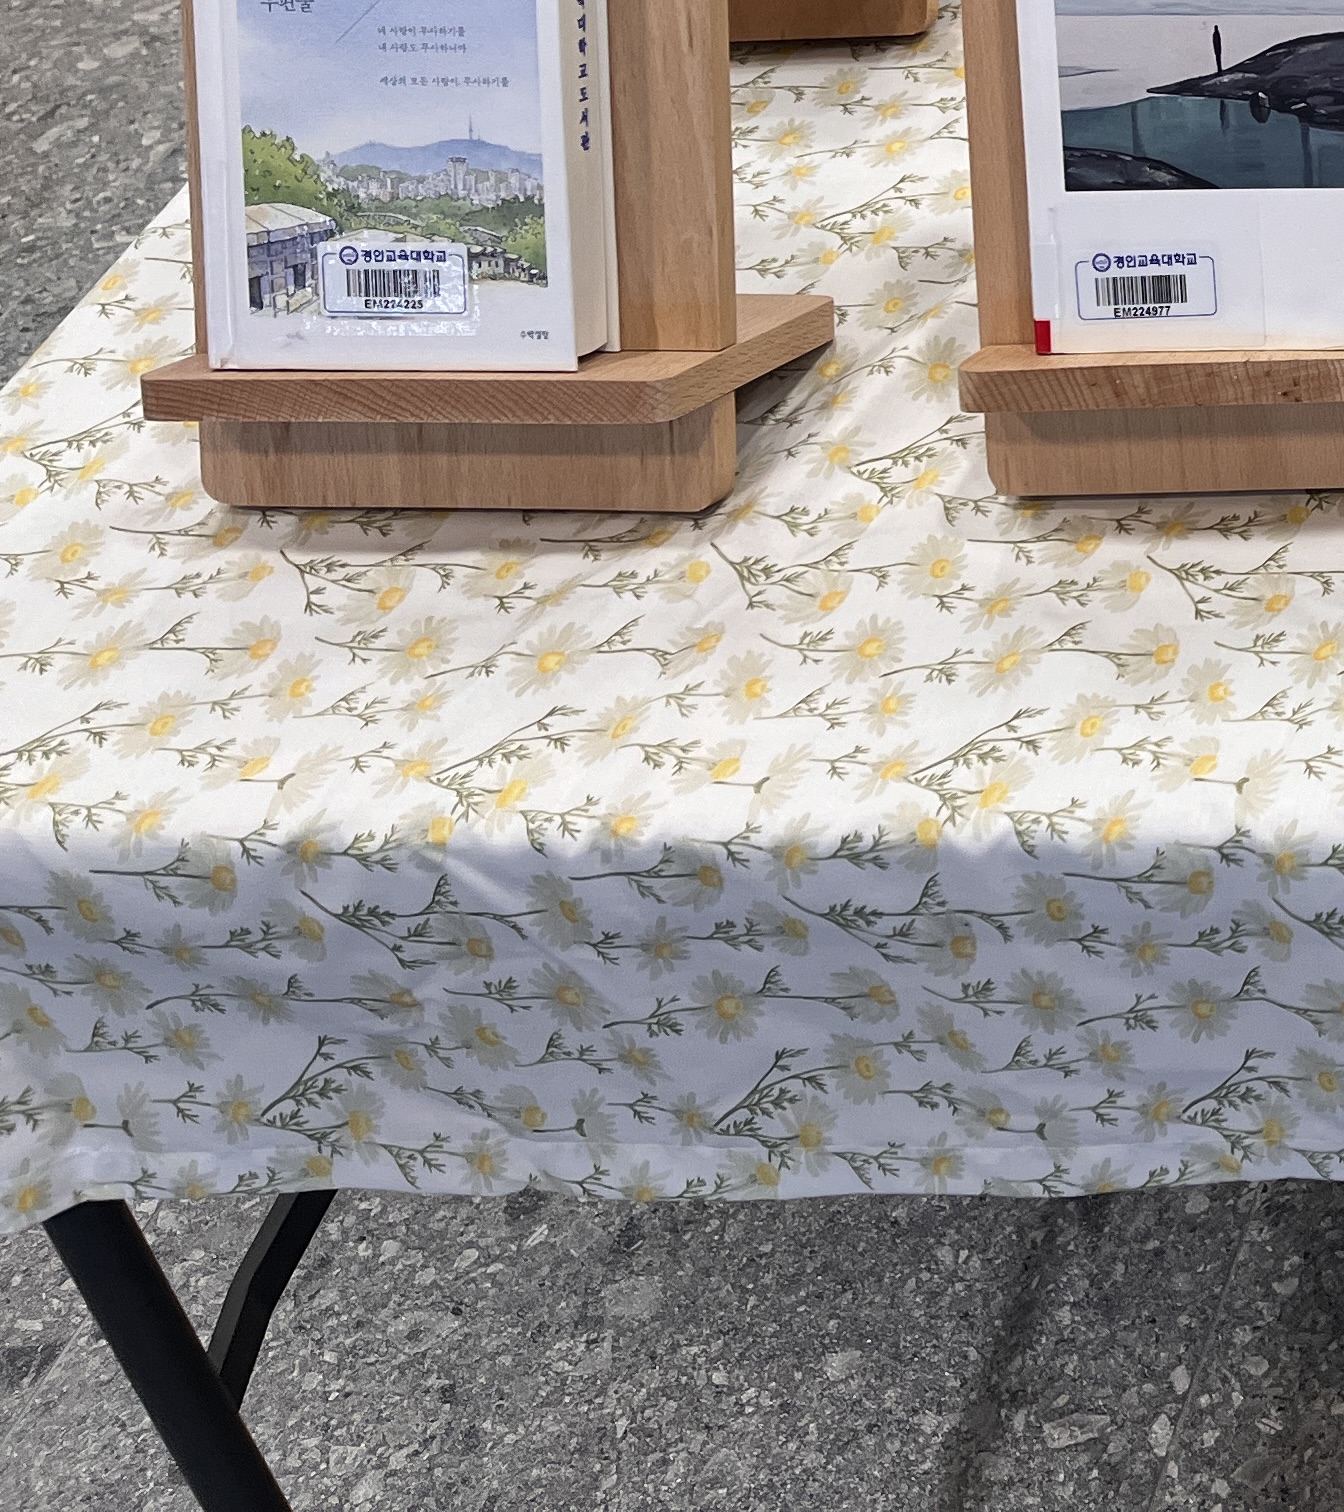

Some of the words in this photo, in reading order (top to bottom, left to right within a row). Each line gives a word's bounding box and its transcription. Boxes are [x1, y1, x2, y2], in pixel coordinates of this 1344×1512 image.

[410, 76, 429, 87] 모든
[360, 249, 447, 264] 경인교육대학교
[1113, 252, 1198, 269] 경인교육대학교
[1113, 305, 1171, 319] EM224977
